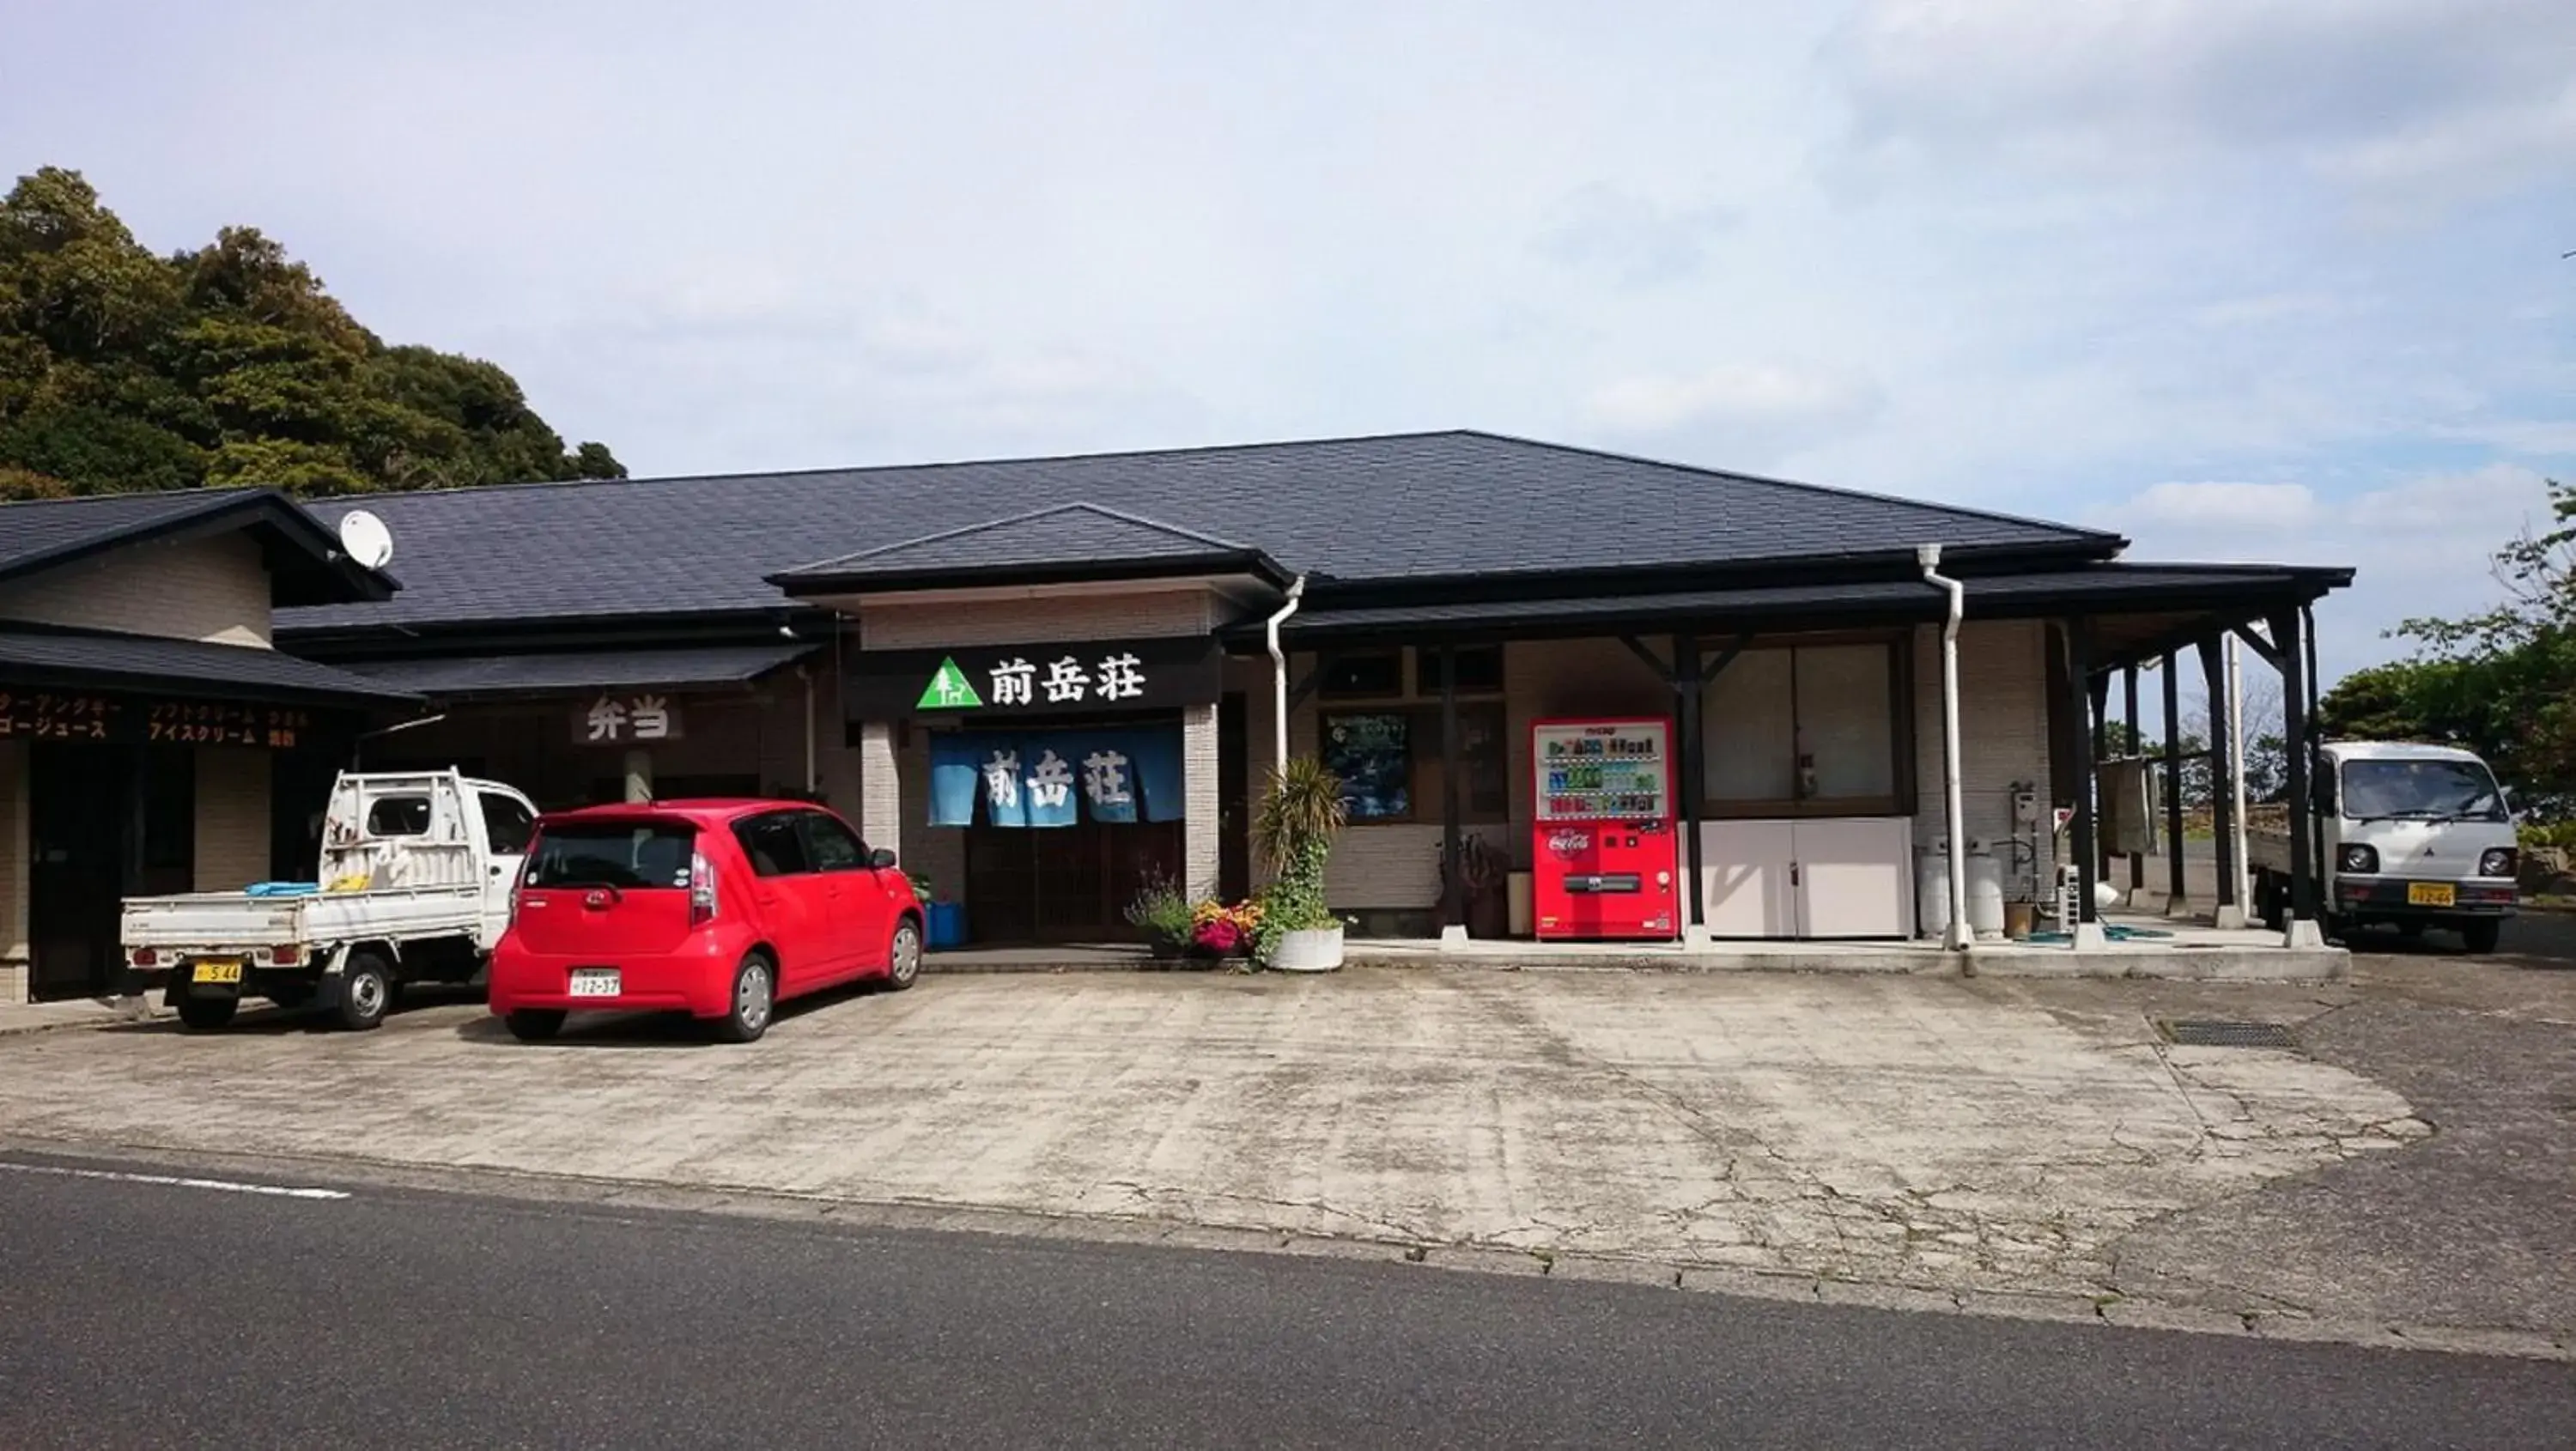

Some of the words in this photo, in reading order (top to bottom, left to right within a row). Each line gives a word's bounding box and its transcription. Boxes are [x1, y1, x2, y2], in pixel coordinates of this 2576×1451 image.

[989, 653, 1145, 705] 前岳荘
[150, 722, 257, 744] アイスクリーム
[587, 691, 668, 740] 弁当
[982, 750, 1132, 807] 前岳荘
